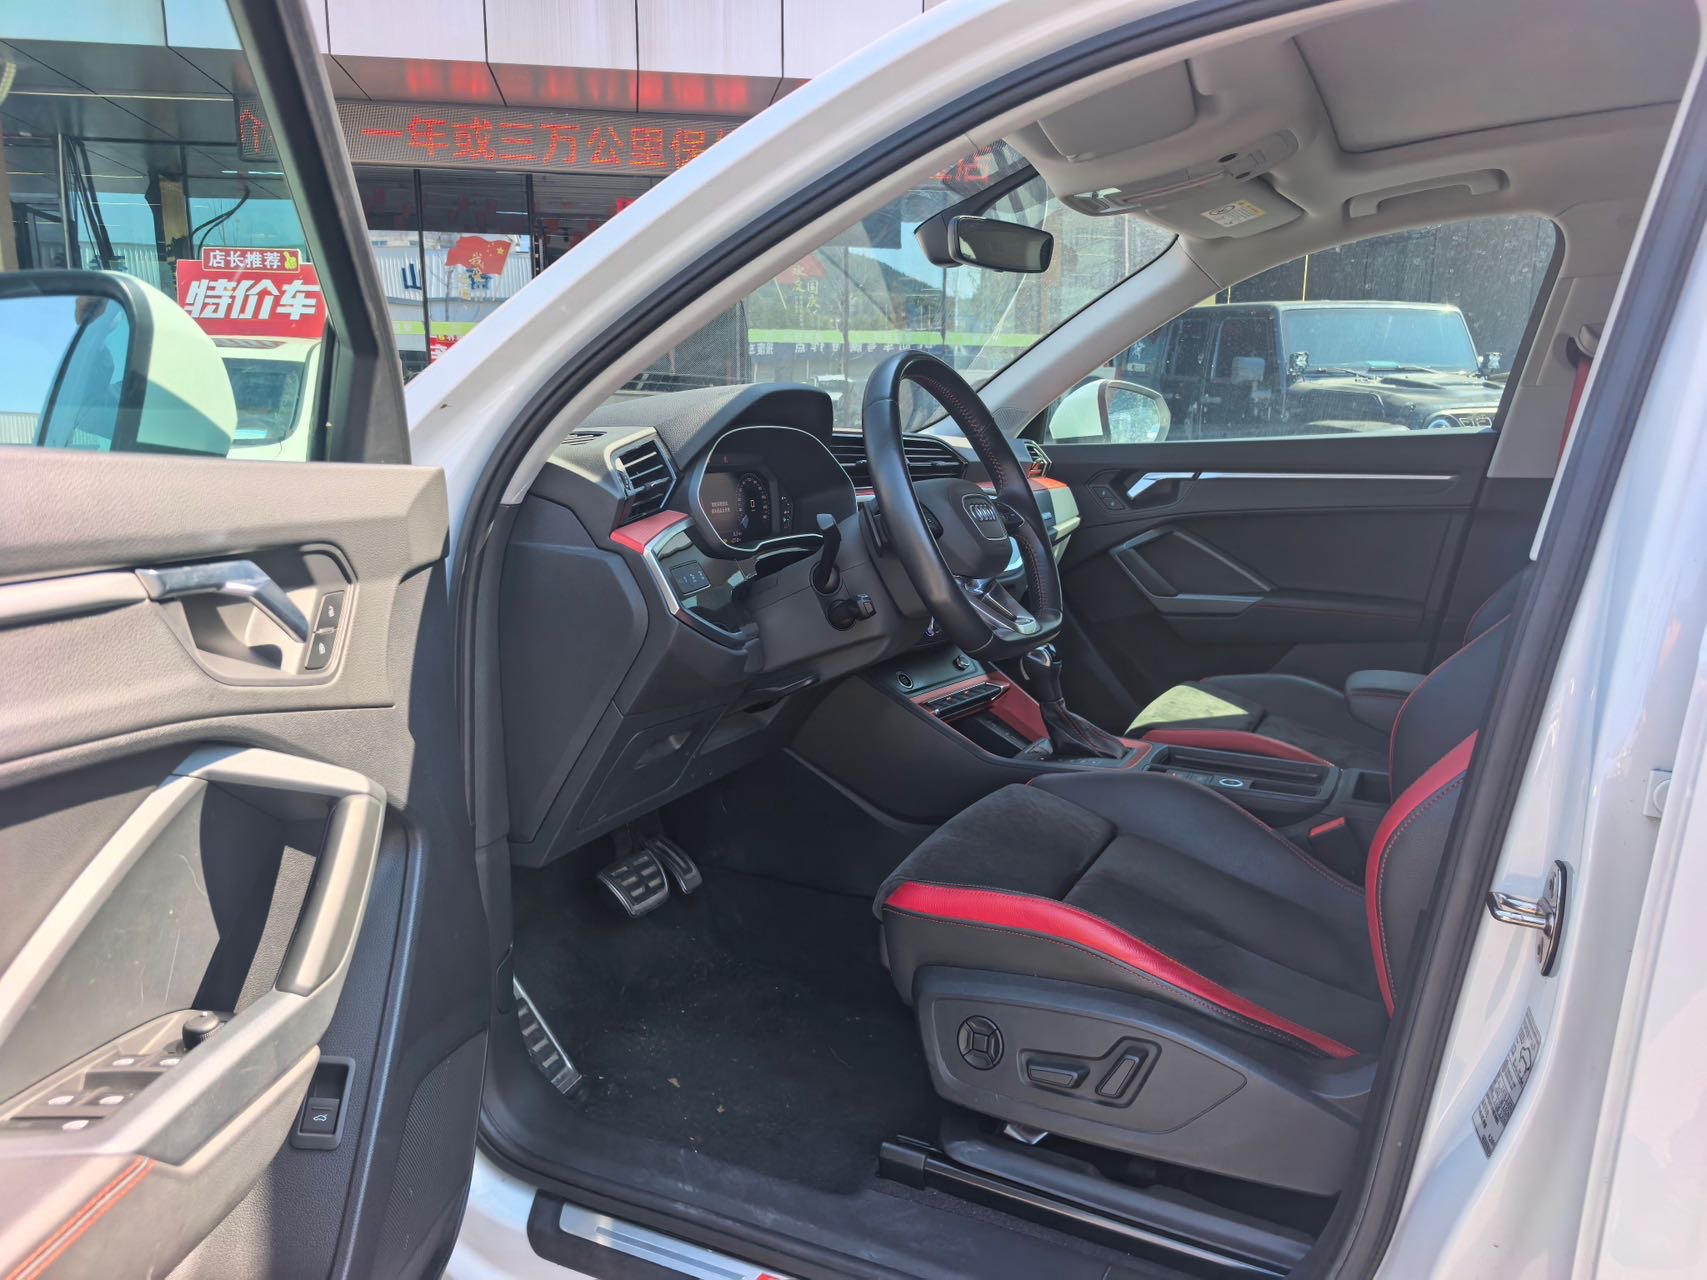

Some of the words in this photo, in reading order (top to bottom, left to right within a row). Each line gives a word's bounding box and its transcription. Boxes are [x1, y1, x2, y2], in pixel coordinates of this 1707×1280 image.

[361, 115, 726, 168] 一年或三万公里保
[208, 249, 281, 269] 店长推荐
[184, 279, 321, 321] 特价车
